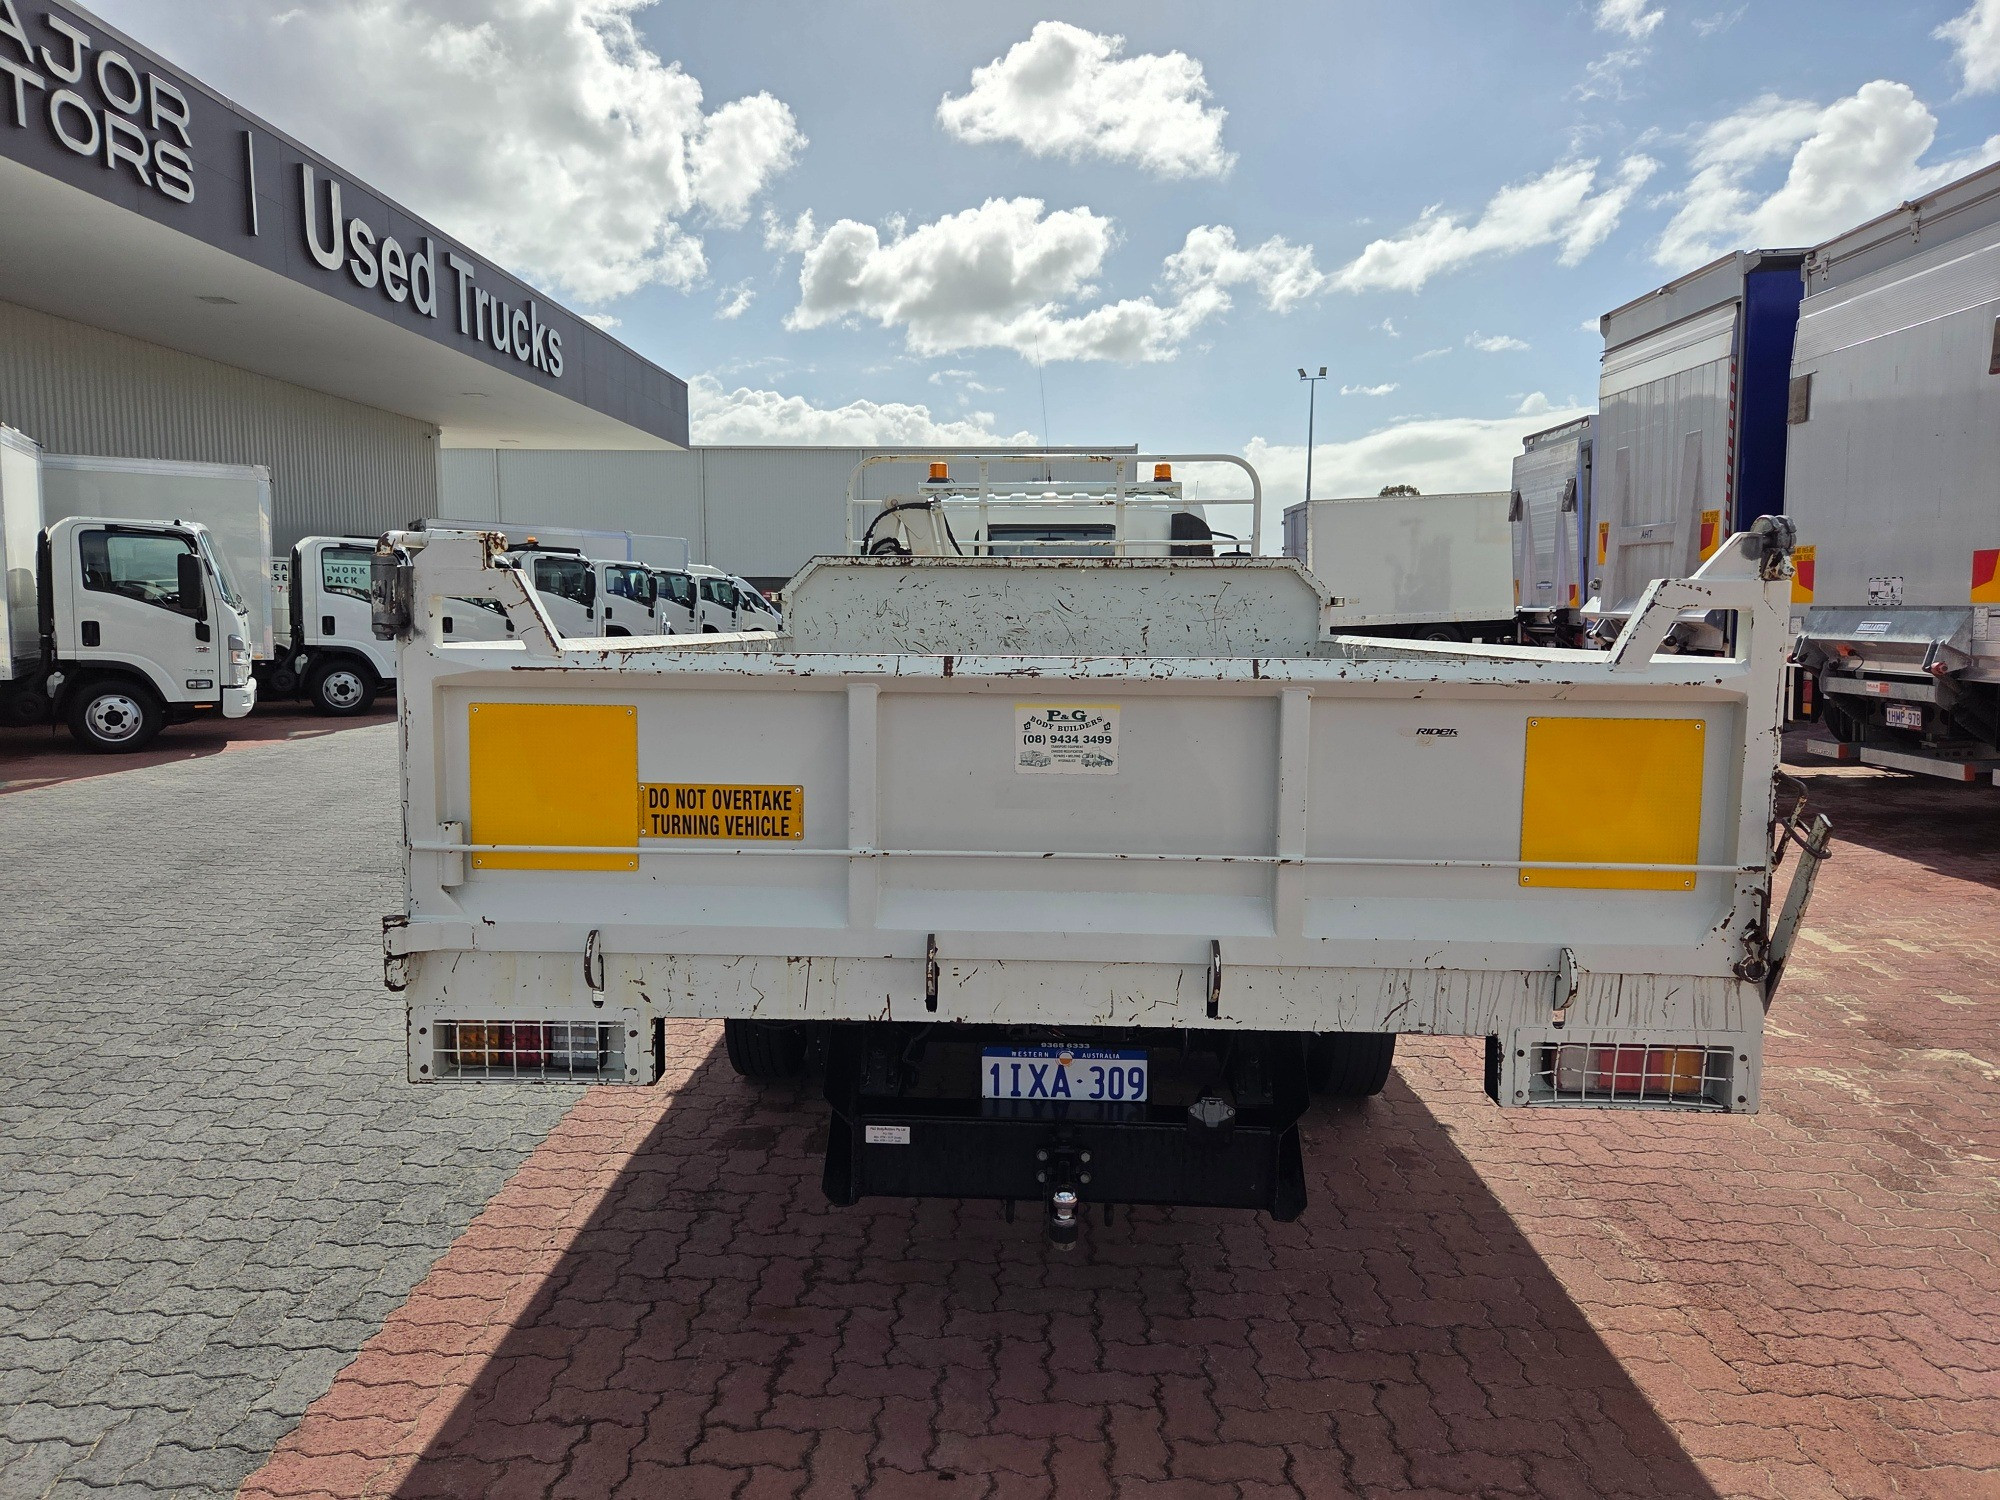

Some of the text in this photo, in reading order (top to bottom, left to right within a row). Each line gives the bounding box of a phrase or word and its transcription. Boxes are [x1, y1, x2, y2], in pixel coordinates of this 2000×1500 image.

[0, 55, 195, 204] TORS
[302, 163, 564, 378] Used Trucks
[1641, 529, 1653, 539] AHT
[271, 563, 288, 571] EA
[326, 576, 358, 584] PACK
[1030, 715, 1103, 732] BODY BUILDERS
[1023, 734, 1112, 745] (08) 9434 3499
[649, 787, 792, 811] DO NOT OVERTAKE
[651, 814, 790, 837] TURNING VEHICLE
